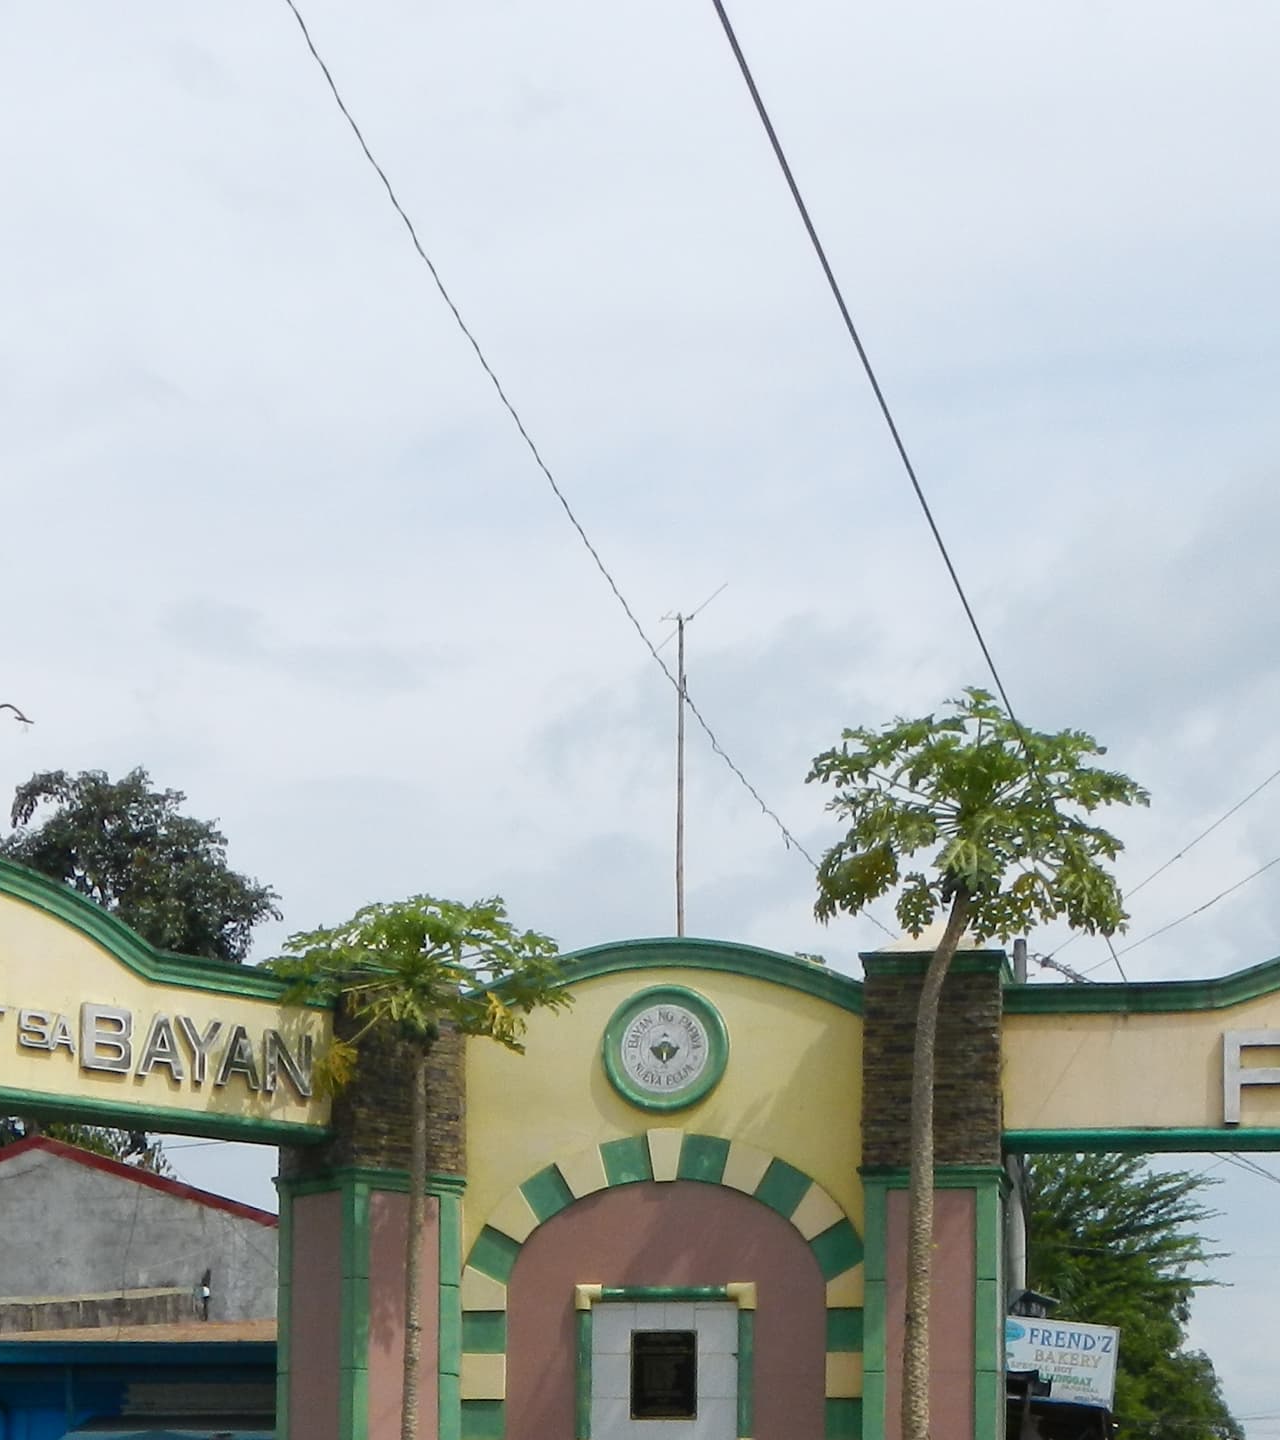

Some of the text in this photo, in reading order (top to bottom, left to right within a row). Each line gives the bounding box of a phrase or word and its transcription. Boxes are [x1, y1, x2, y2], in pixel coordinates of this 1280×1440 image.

[628, 1015, 654, 1049] BAYAN
[657, 1009, 674, 1022] NG
[19, 1008, 77, 1054] SA
[80, 1002, 314, 1098] BAYAN
[634, 1062, 695, 1086] NUEVA ECIJA
[1029, 1328, 1113, 1353] FREND'Z
[1034, 1348, 1102, 1369] BAKERY
